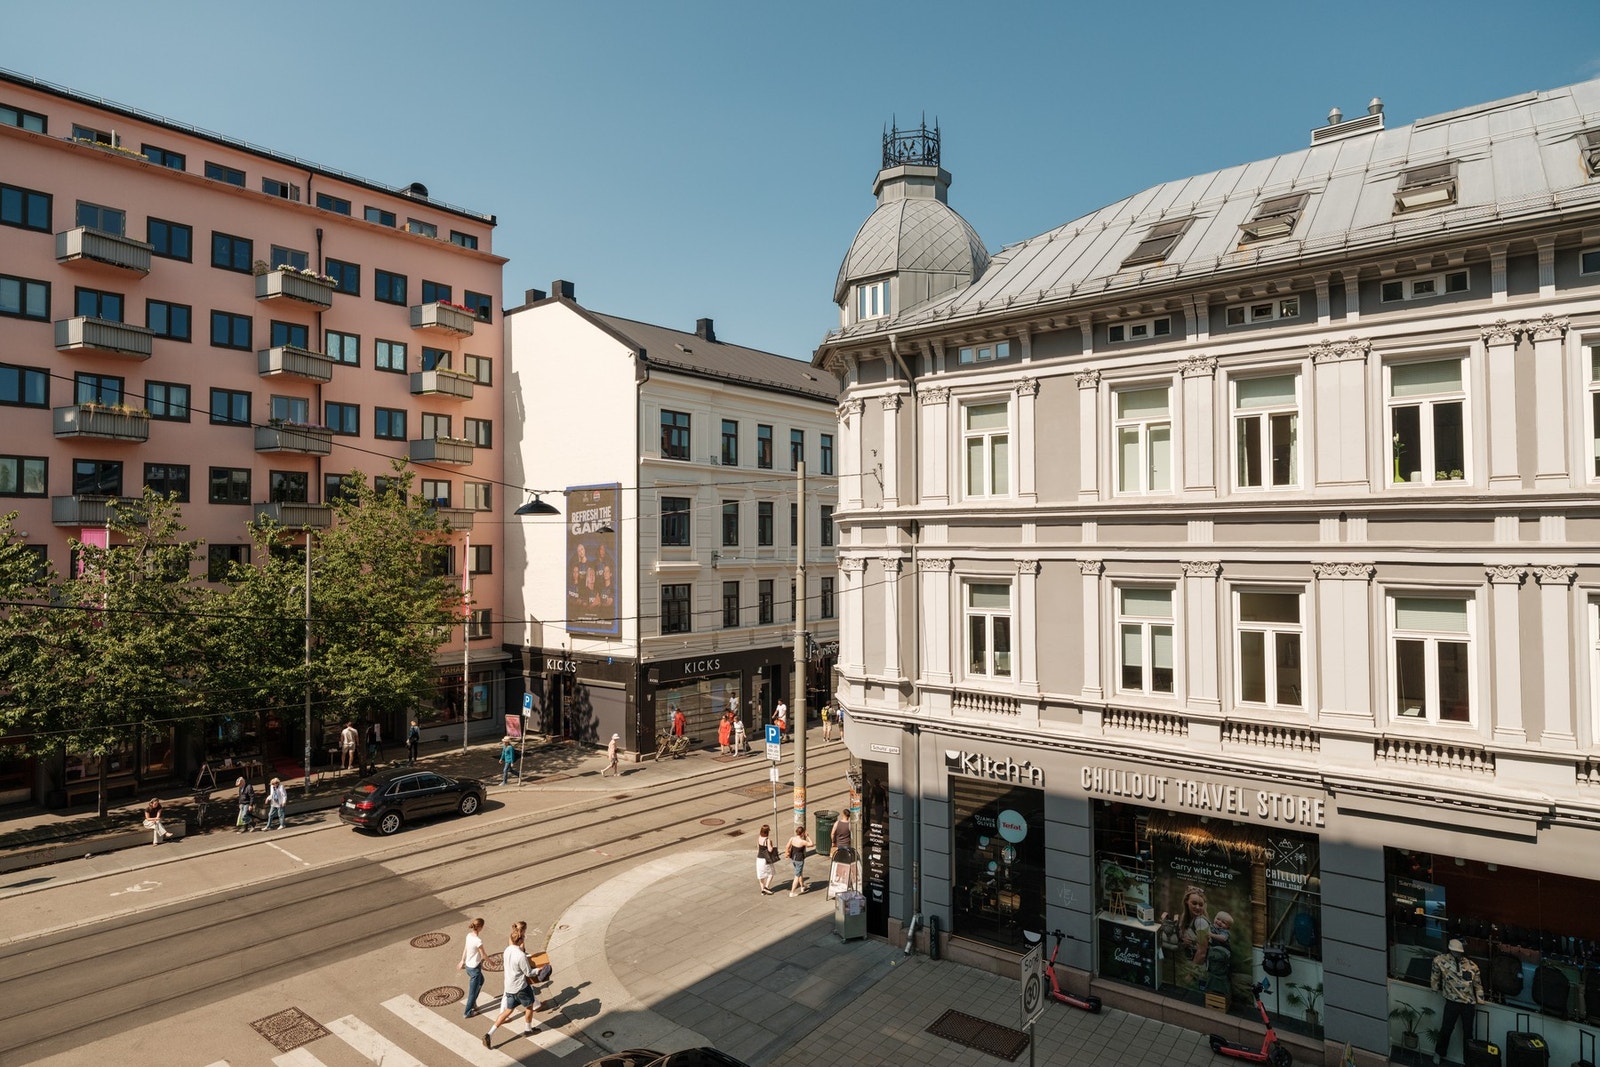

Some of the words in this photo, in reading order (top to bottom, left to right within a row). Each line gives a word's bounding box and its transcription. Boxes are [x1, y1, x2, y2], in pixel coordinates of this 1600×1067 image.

[572, 508, 598, 522] REFRESH
[599, 506, 611, 518] THE
[547, 658, 577, 673] KICKS
[685, 659, 721, 674] KICKS
[769, 727, 777, 741] P
[1080, 766, 1168, 801] CHILLOUT
[1175, 778, 1249, 816] TRAVEL
[1256, 790, 1326, 827] STORE
[1002, 821, 1022, 831] Tefal
[1170, 861, 1193, 873] Carry
[1193, 866, 1212, 876] with
[1213, 870, 1234, 880] Care
[1265, 868, 1308, 885] CHILLOUT
[1026, 981, 1037, 1006] 30
